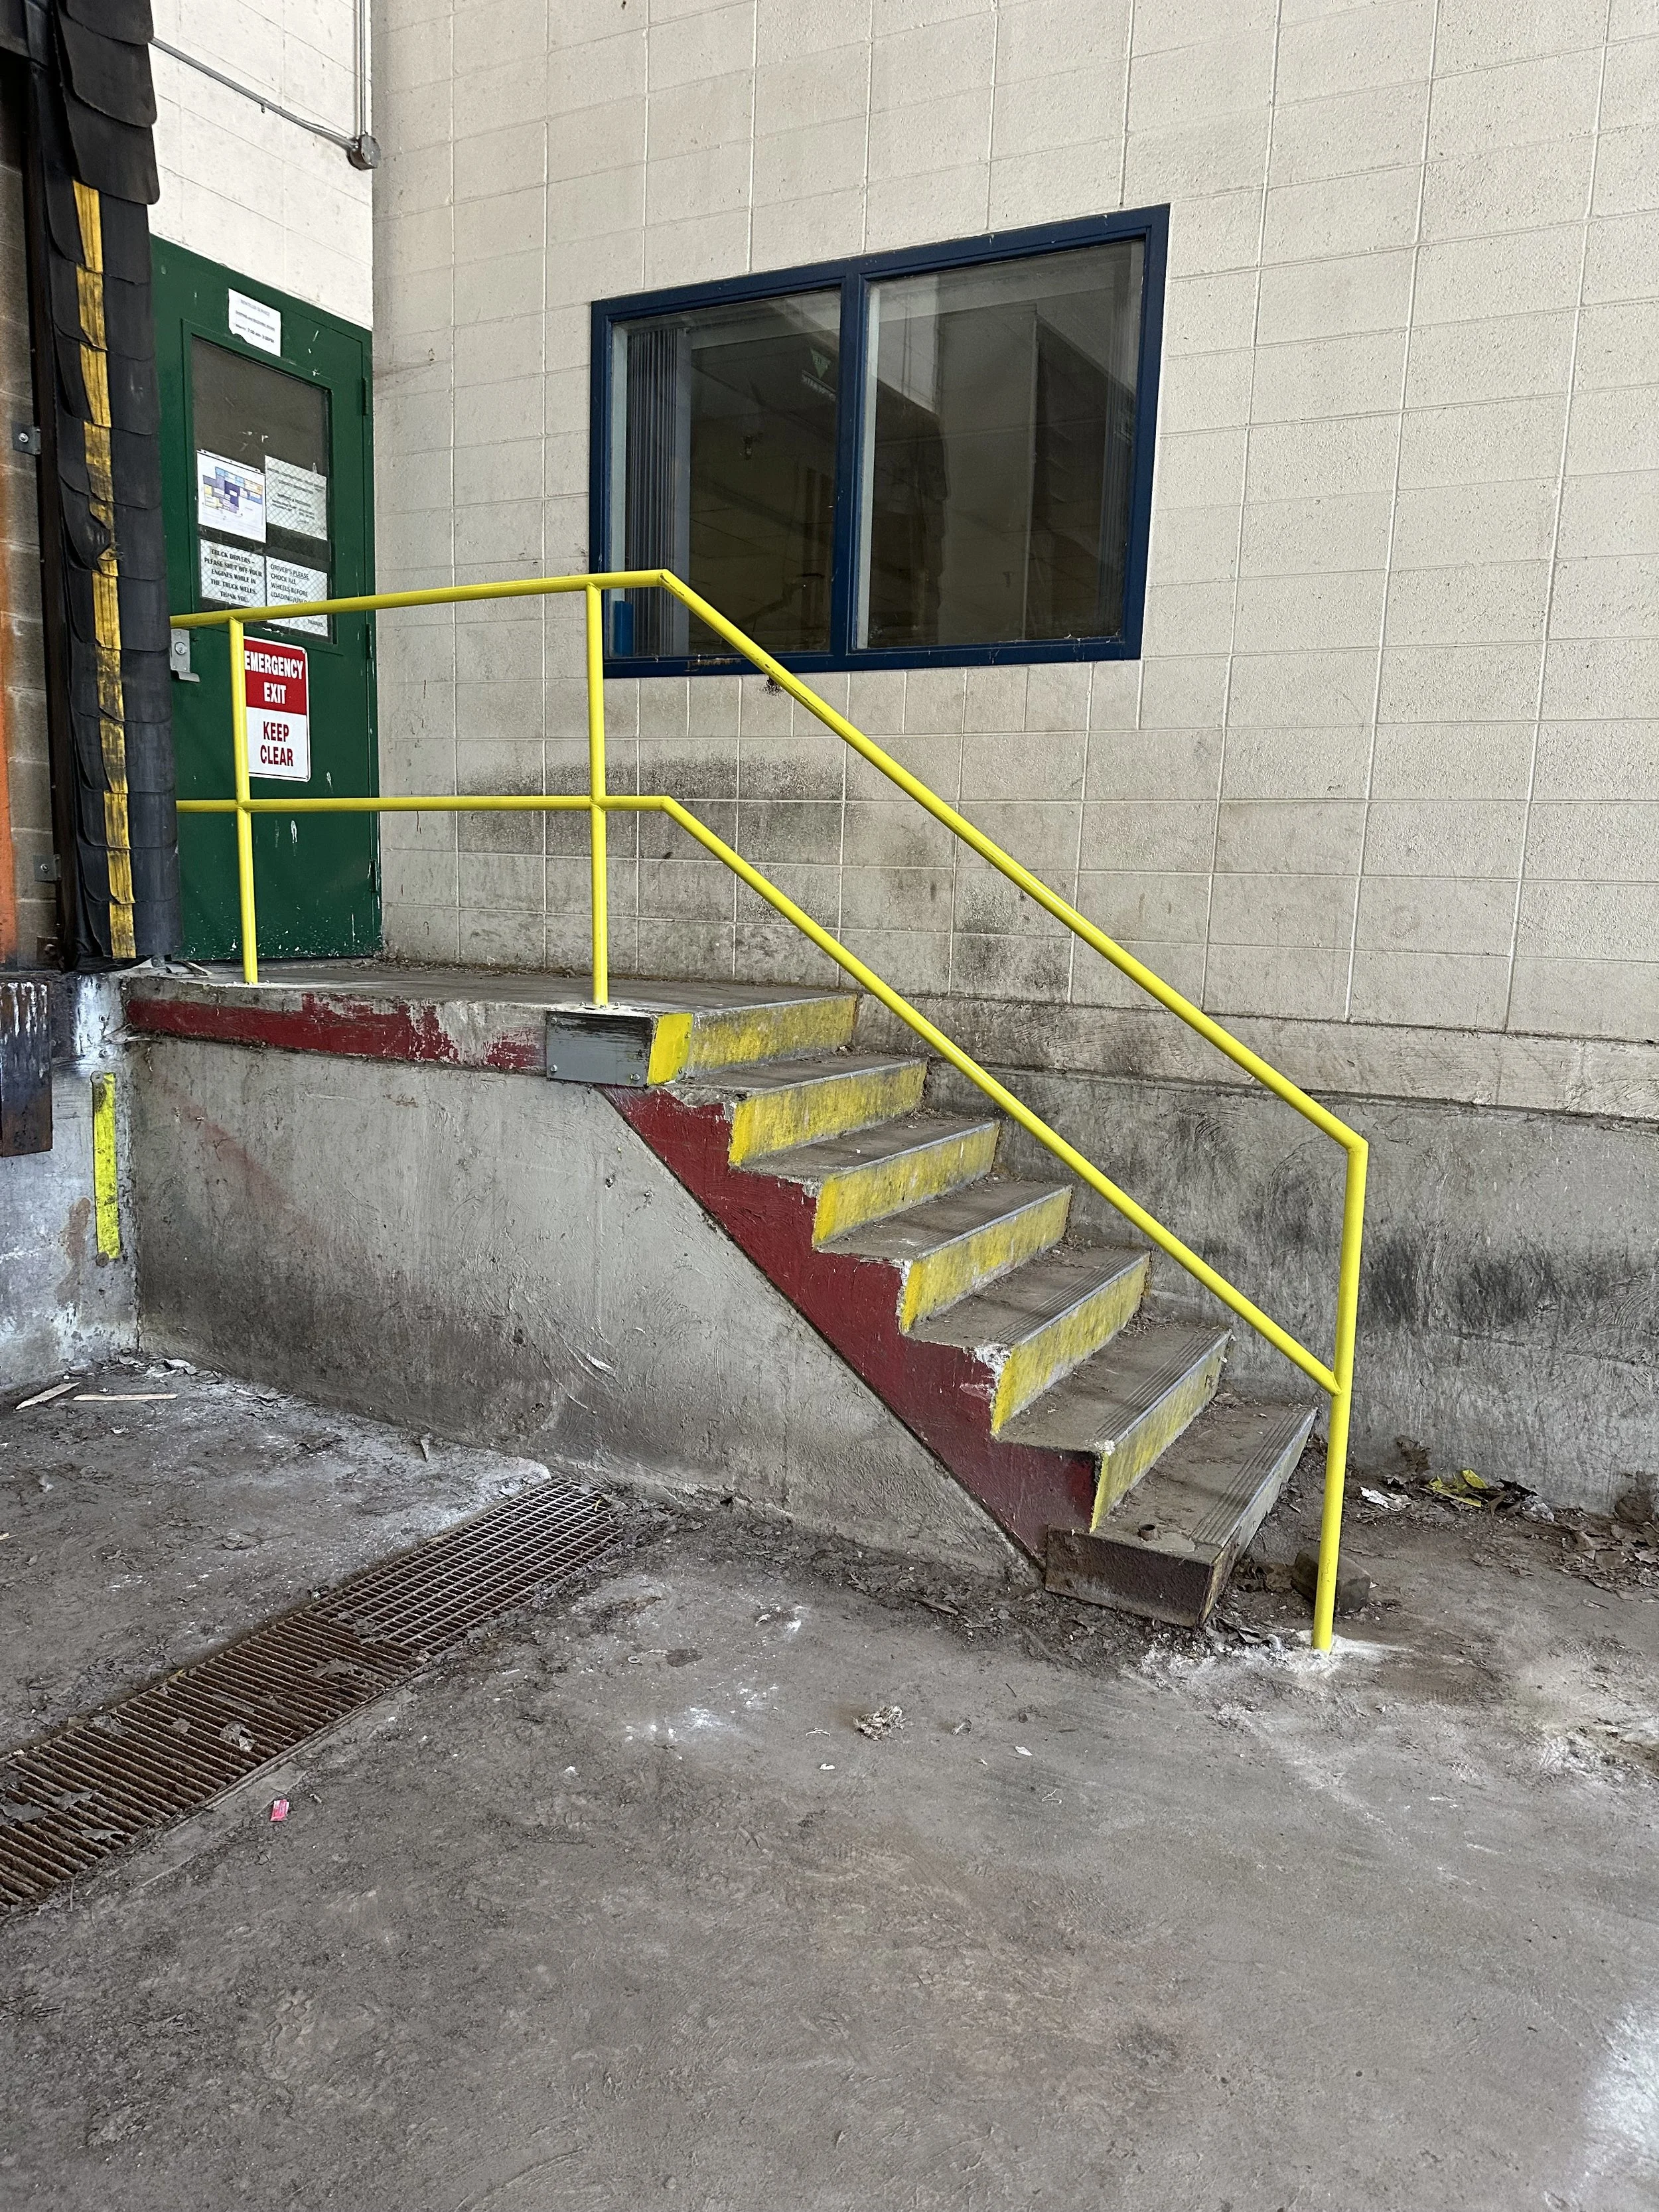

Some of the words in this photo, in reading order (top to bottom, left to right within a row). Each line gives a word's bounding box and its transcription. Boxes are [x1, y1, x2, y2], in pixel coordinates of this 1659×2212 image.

[211, 549, 228, 558] TRUCK
[230, 553, 251, 563] DRIVERS
[204, 557, 223, 567] PLEASE
[224, 562, 237, 571] SHUT
[249, 568, 262, 577] YOUR
[271, 564, 292, 574] DRIVER'S
[293, 570, 309, 579] PLEASE
[211, 569, 233, 579] ENGINES
[234, 574, 249, 583] WHILE
[271, 573, 287, 582] CHOCK
[222, 581, 238, 590] TRUCK
[271, 582, 290, 593] WHEELS
[291, 587, 308, 597] BEFORE
[220, 591, 236, 600] THANK
[244, 650, 303, 680] EMERGENCY
[263, 682, 287, 704] EXIT
[263, 721, 289, 742] KEEP
[260, 745, 294, 767] CLEAR
